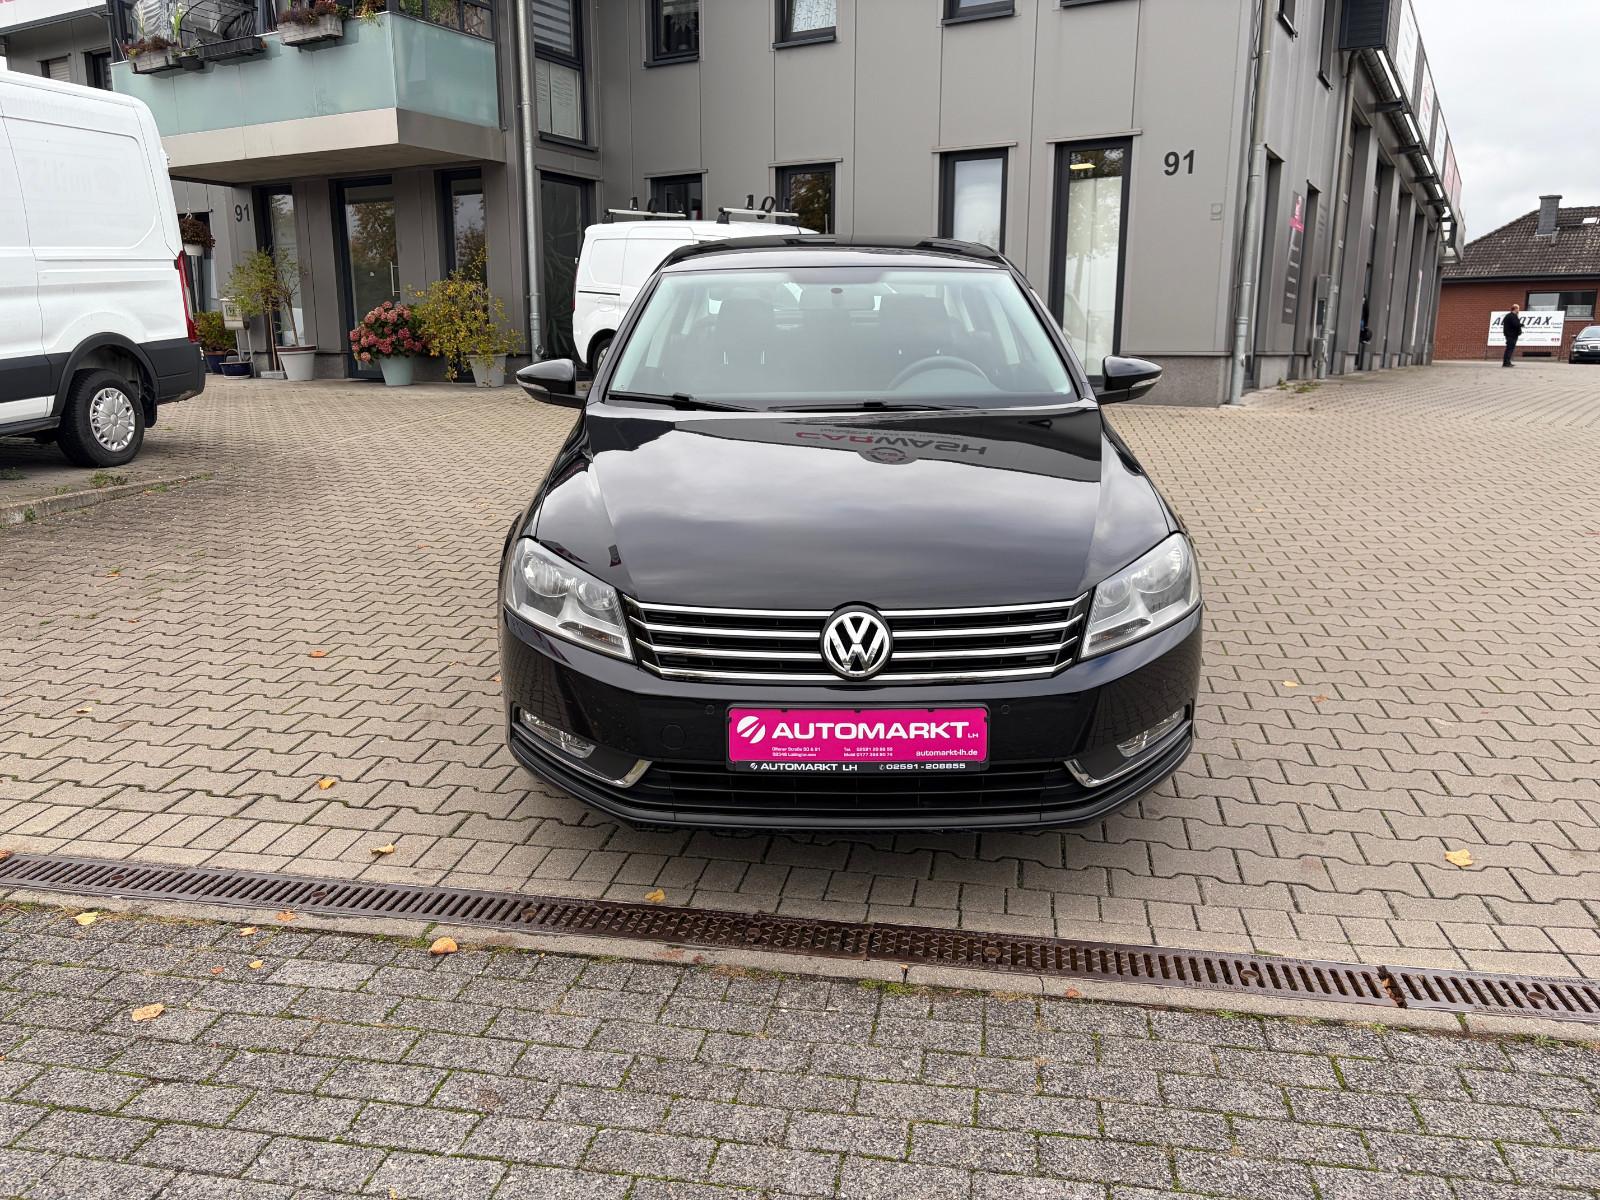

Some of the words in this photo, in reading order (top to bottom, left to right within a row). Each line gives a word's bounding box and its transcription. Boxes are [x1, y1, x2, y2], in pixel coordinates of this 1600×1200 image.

[1164, 150, 1195, 176] 91
[235, 204, 250, 222] 91
[1492, 316, 1553, 326] AOTAX
[771, 721, 970, 740] AUTOMARKT
[915, 748, 979, 758] automarkt-lh.de
[760, 762, 839, 771] AUTOMARKT
